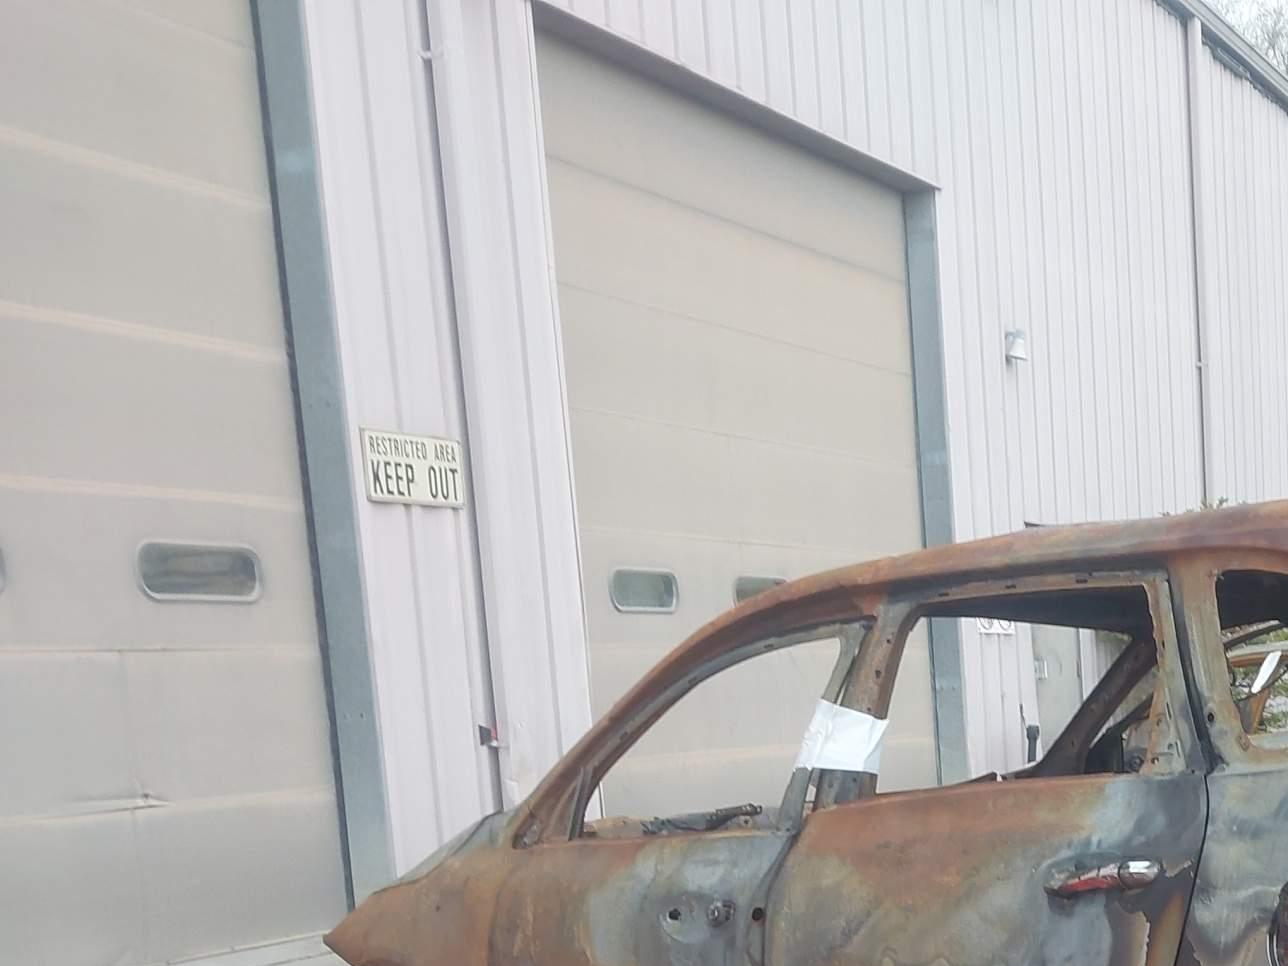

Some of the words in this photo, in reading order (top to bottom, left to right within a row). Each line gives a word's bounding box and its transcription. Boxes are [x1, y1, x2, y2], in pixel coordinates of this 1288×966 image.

[368, 434, 427, 460] RESTRICTED
[433, 443, 457, 463] AREA
[370, 458, 415, 498] KEEP
[427, 465, 458, 501] OUT
